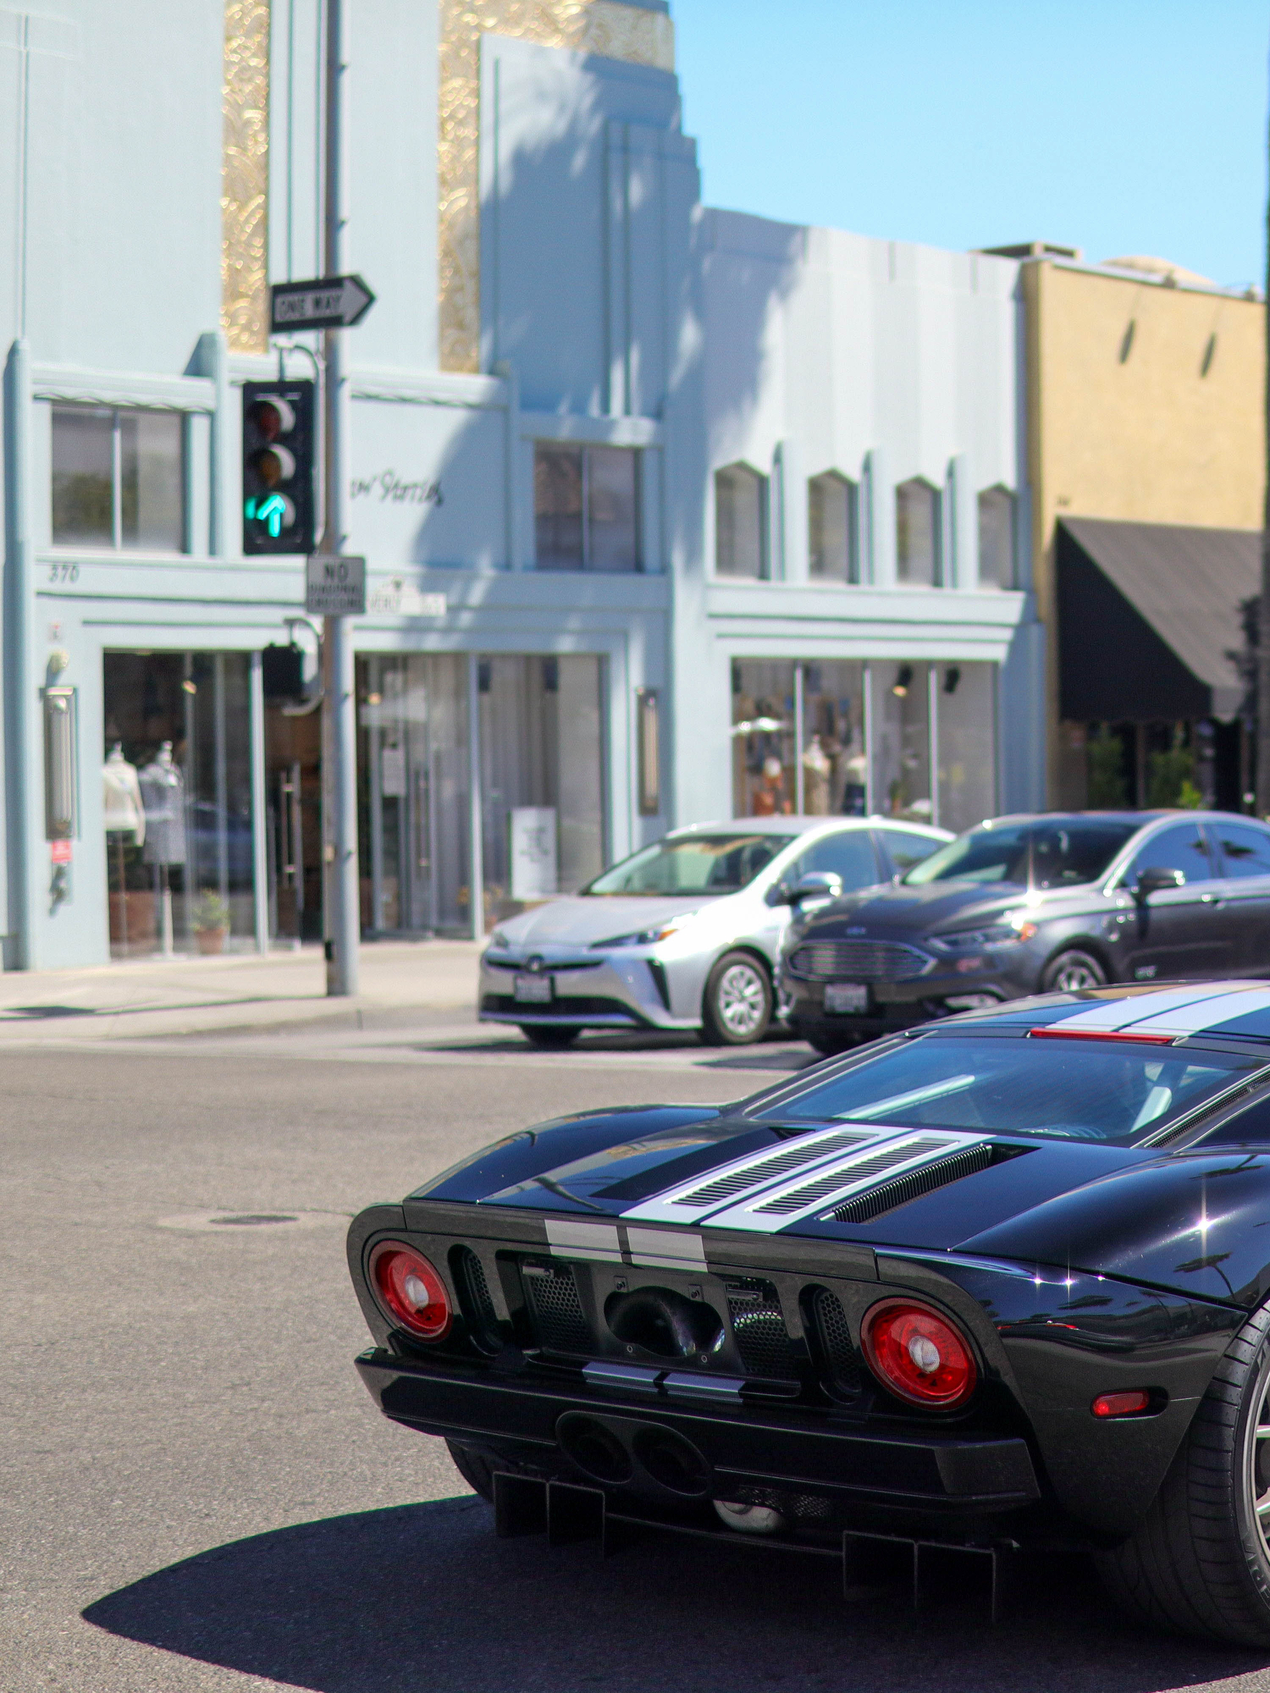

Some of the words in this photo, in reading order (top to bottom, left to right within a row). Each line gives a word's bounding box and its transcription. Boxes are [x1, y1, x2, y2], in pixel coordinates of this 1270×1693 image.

[277, 295, 307, 319] ONE
[312, 292, 342, 313] WAY
[48, 563, 80, 583] 370
[324, 562, 349, 582] NO
